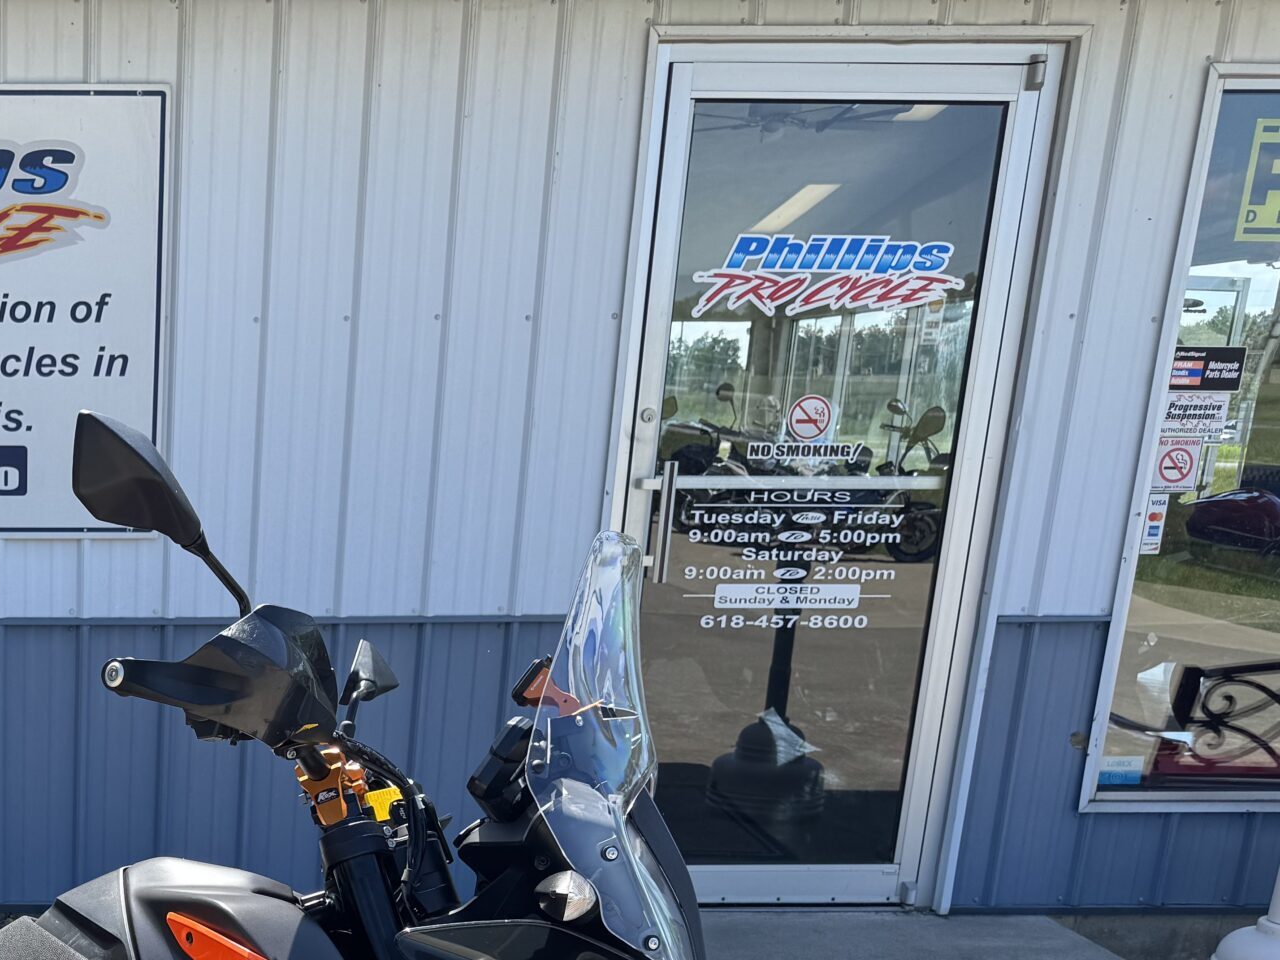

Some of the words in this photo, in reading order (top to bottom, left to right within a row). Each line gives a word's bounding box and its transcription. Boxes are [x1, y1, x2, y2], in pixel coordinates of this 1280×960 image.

[724, 235, 953, 275] Phillips
[694, 271, 802, 317] PRO
[788, 272, 963, 315] CYCLE
[69, 293, 112, 324] of
[93, 345, 130, 378] in
[1208, 360, 1239, 371] Motorcycle
[1205, 370, 1220, 379] Parts
[1221, 370, 1240, 379] Dealer
[1168, 402, 1223, 413] Progressive
[1165, 411, 1216, 422] Suspension
[748, 443, 774, 459] NO
[750, 490, 852, 503] HOURS
[690, 510, 786, 527] Tuesday
[832, 510, 905, 527] Friday
[688, 529, 771, 544] 9:00am
[818, 529, 902, 546] 5:00pm
[741, 547, 844, 563] Saturday
[684, 566, 766, 581] 9:00am
[812, 566, 896, 583] 2:00pm
[754, 586, 821, 596] CLOSED
[718, 595, 775, 606] Sunday
[779, 596, 790, 605] &
[795, 596, 855, 606] Monday
[699, 614, 869, 629] 618-457-8600
